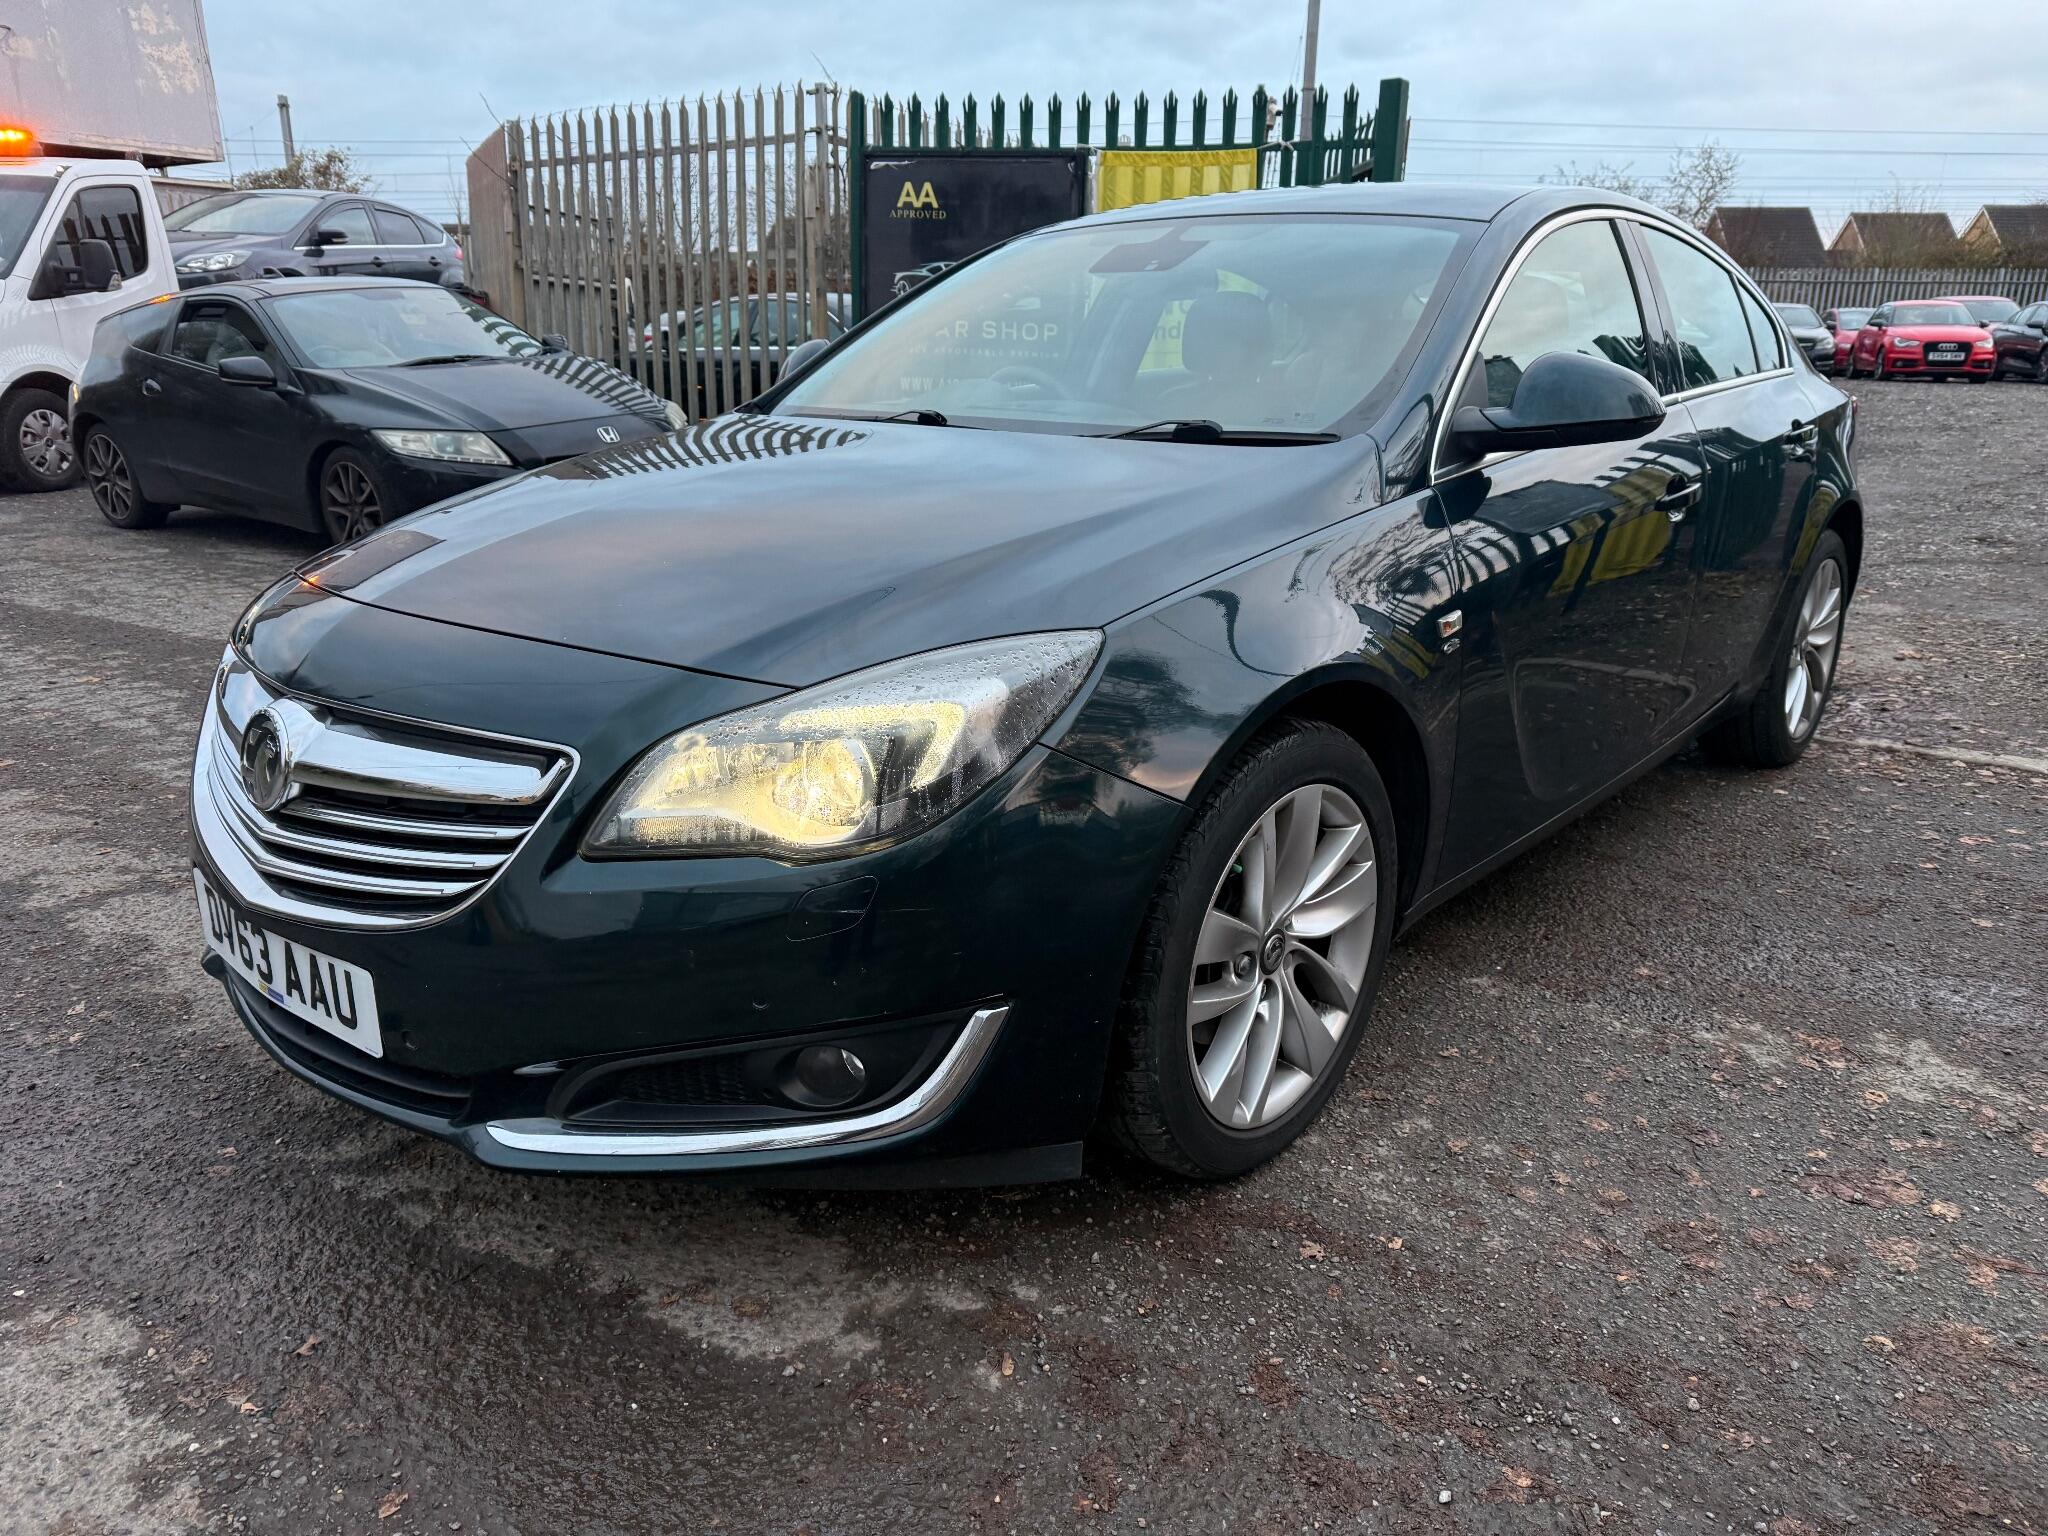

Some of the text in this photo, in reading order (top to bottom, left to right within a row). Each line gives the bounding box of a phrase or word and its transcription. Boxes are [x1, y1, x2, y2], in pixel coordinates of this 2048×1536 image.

[896, 181, 939, 208] AA
[888, 209, 948, 219] APPROVED
[935, 320, 1059, 342] AR SHOP
[204, 884, 358, 1031] DV63 AAU
